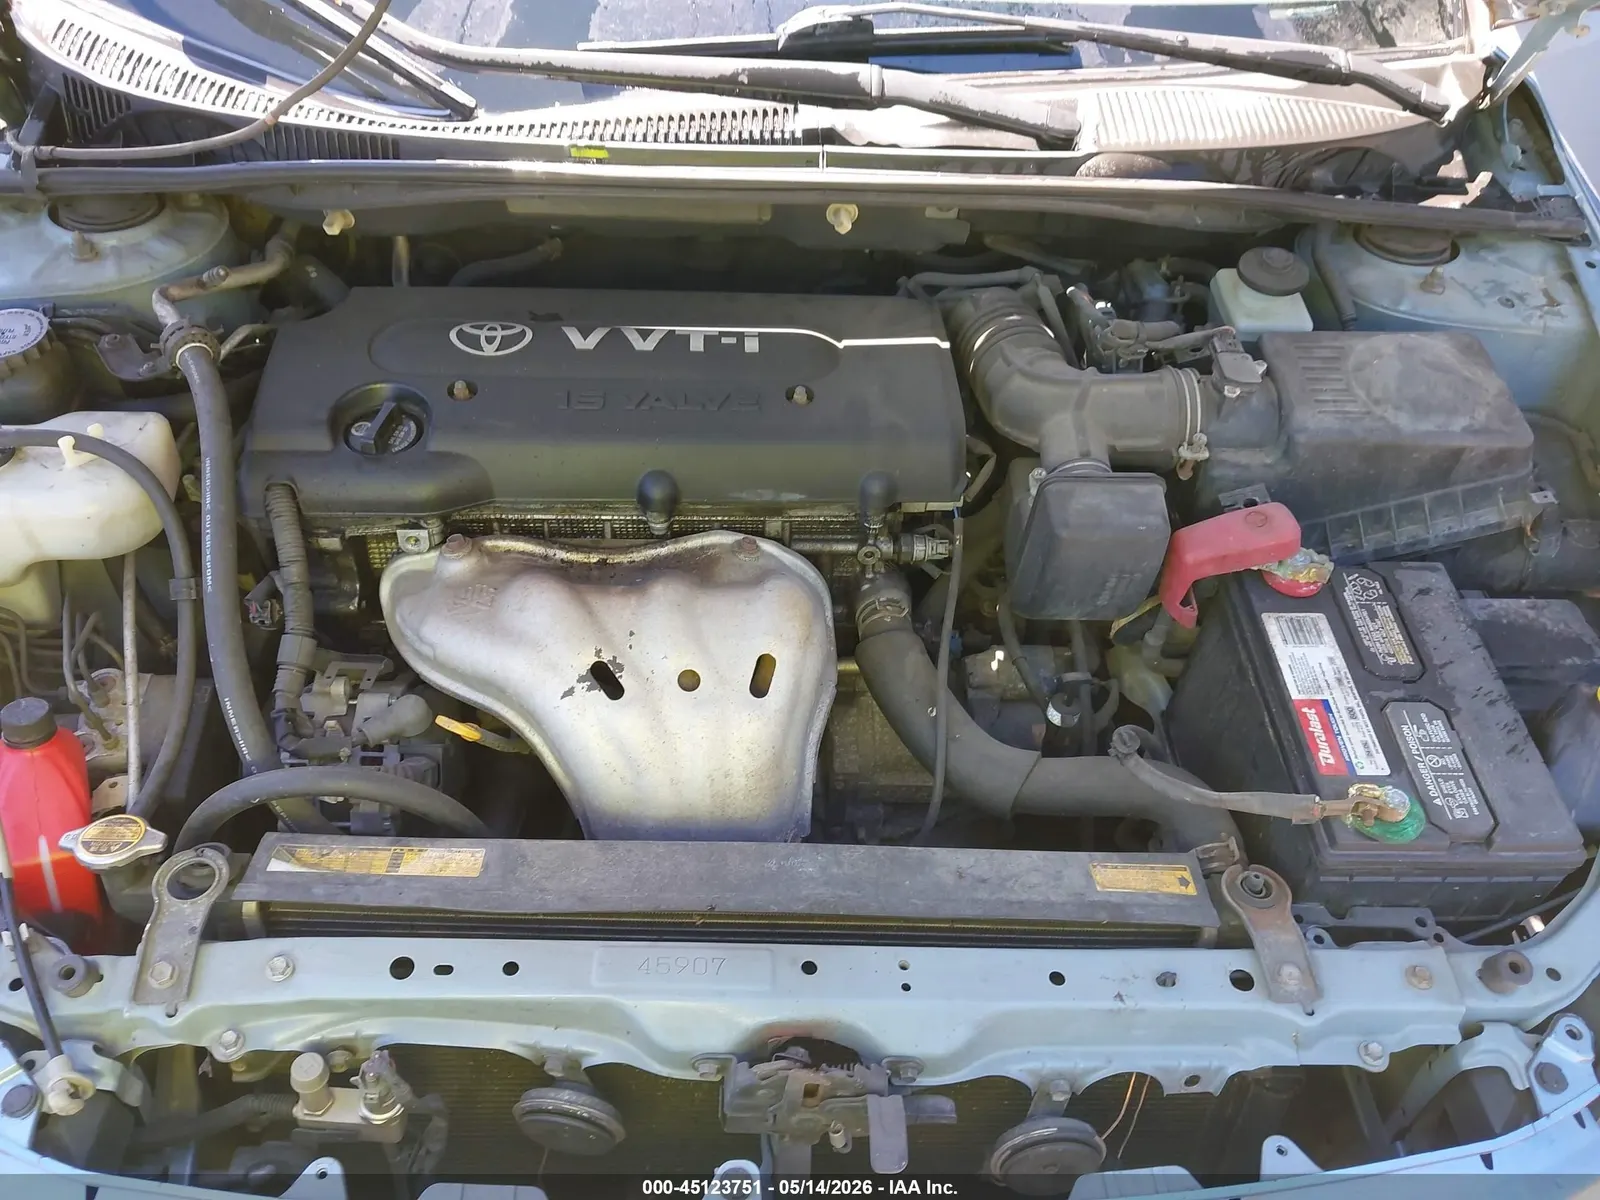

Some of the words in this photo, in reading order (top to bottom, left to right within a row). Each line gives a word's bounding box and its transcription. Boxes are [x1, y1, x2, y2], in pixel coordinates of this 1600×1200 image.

[561, 325, 759, 353] VVT-i
[621, 389, 763, 412] VALVE
[1345, 706, 1358, 720] 600
[1300, 706, 1336, 767] Duralast
[1400, 724, 1420, 755] POISON
[1416, 762, 1438, 797] DANGER
[637, 956, 728, 976] 45907
